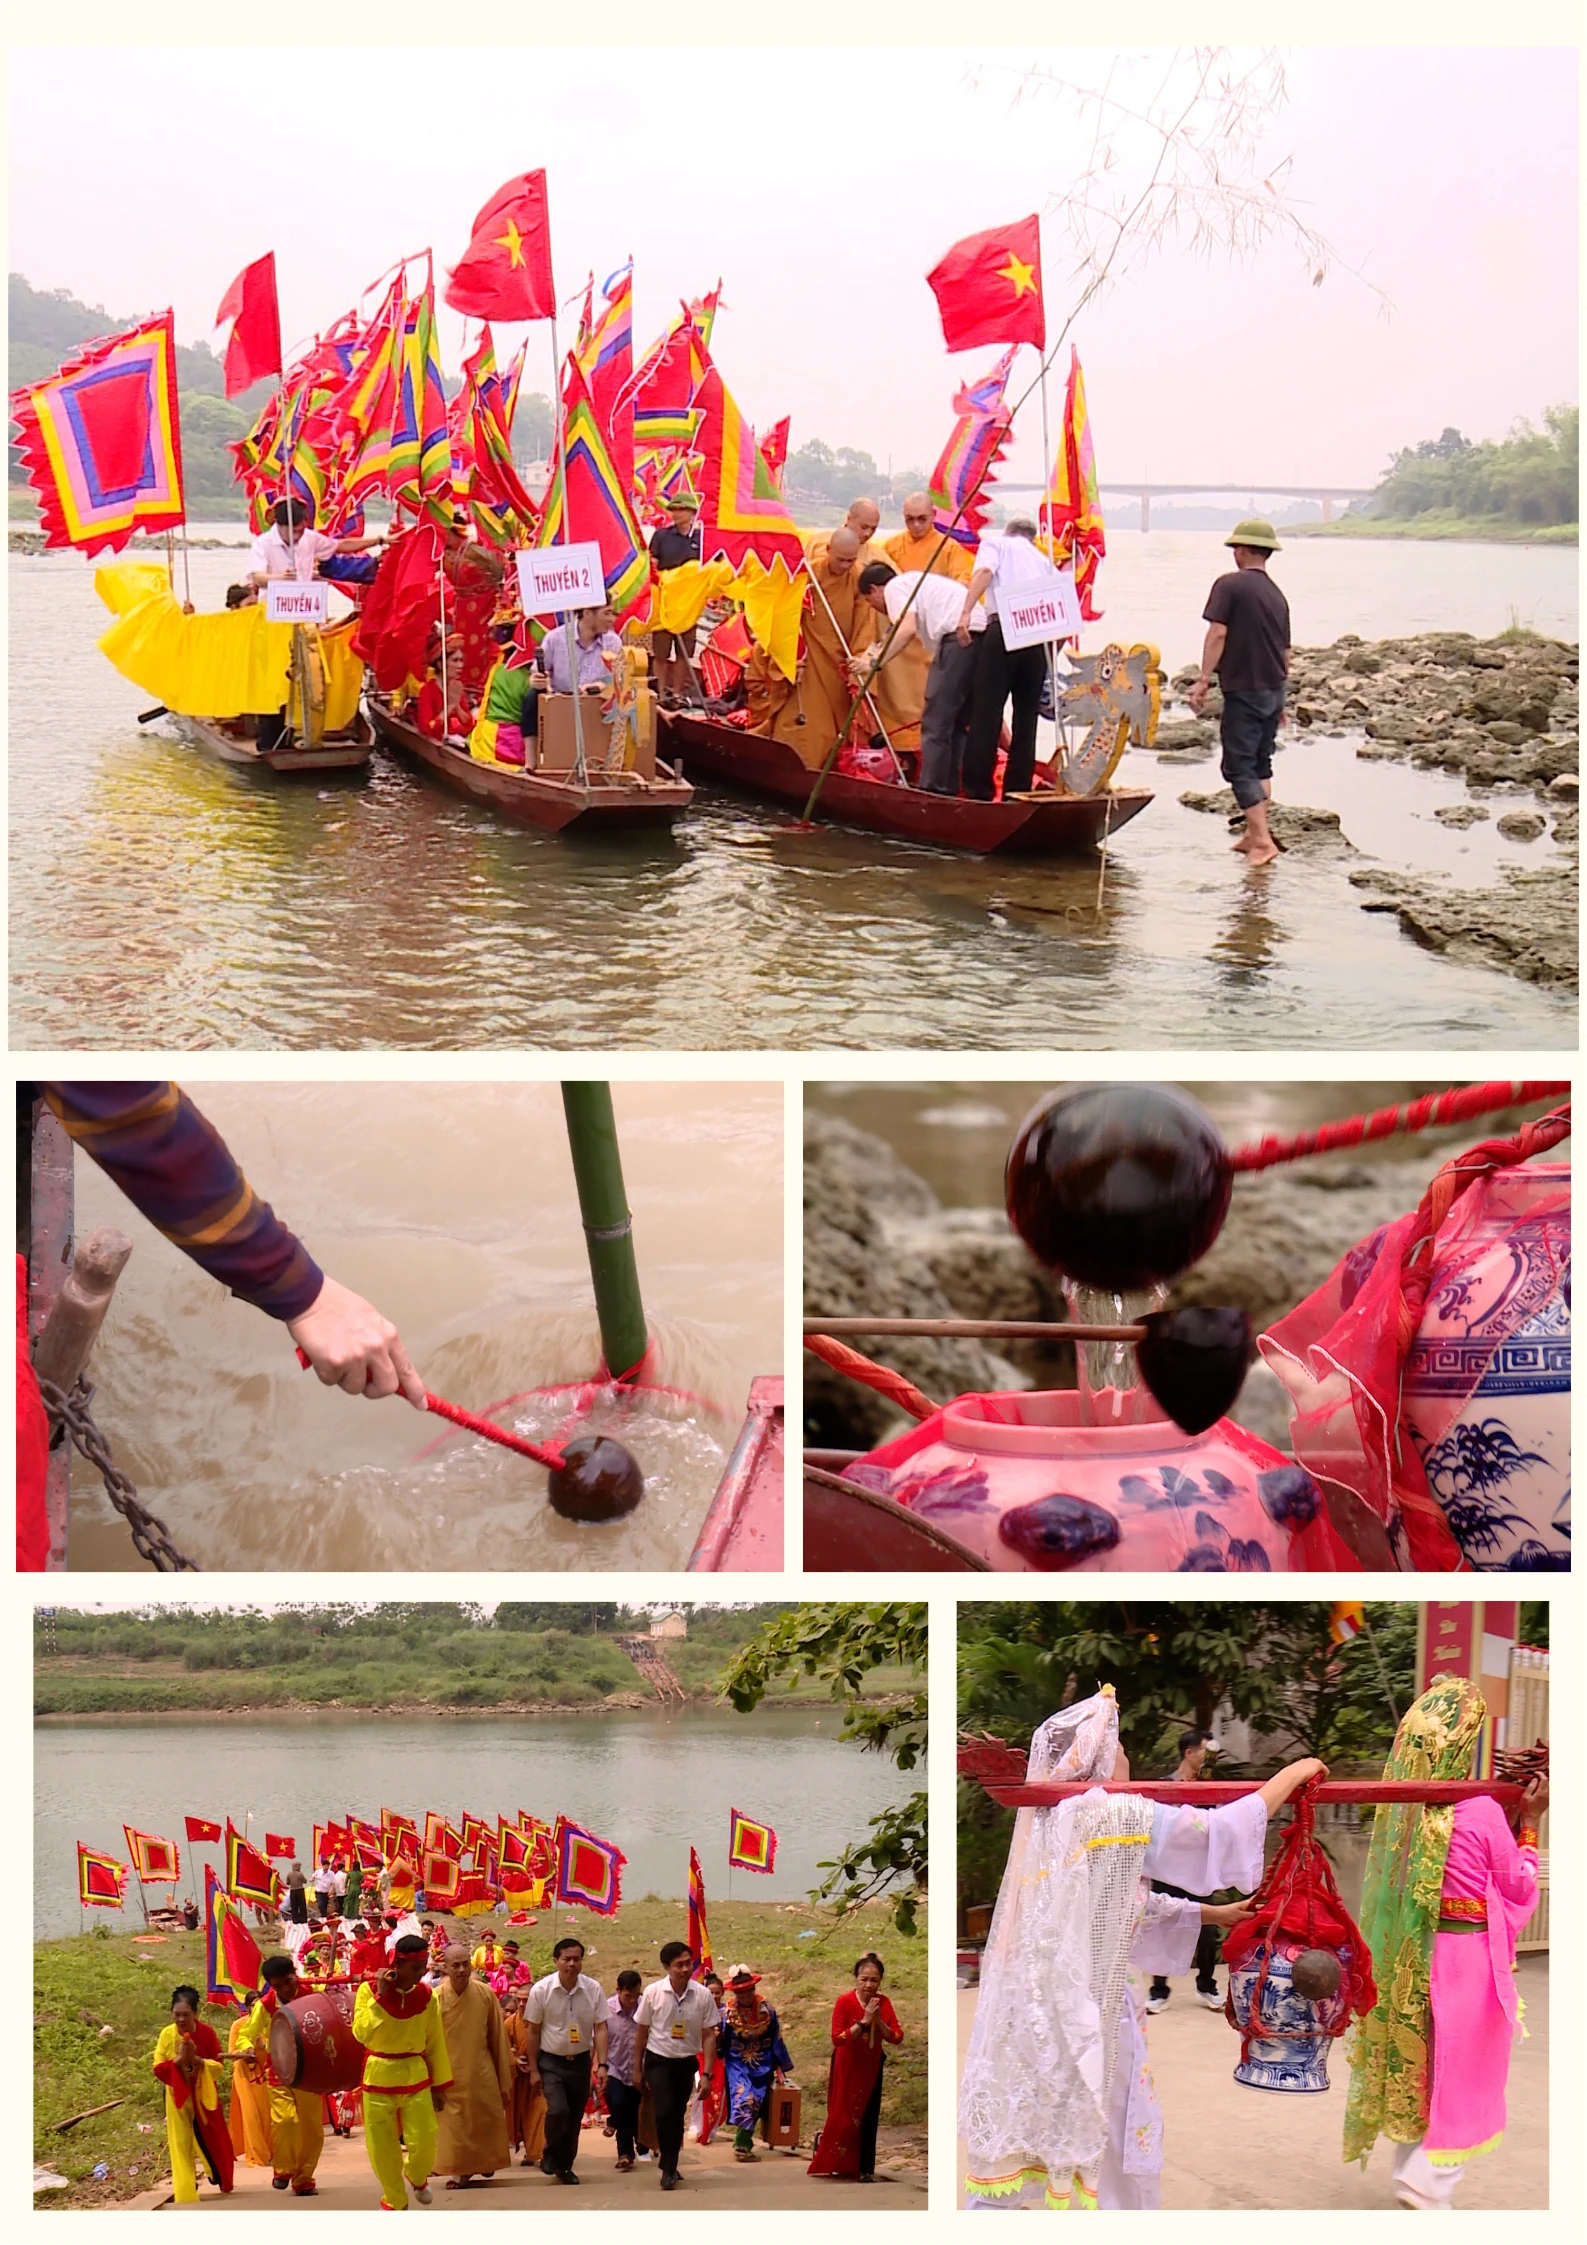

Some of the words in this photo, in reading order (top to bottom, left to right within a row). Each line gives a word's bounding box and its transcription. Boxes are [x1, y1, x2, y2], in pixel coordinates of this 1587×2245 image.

[582, 568, 590, 588] 2
[314, 596, 320, 612] 4
[1058, 600, 1065, 619] 1
